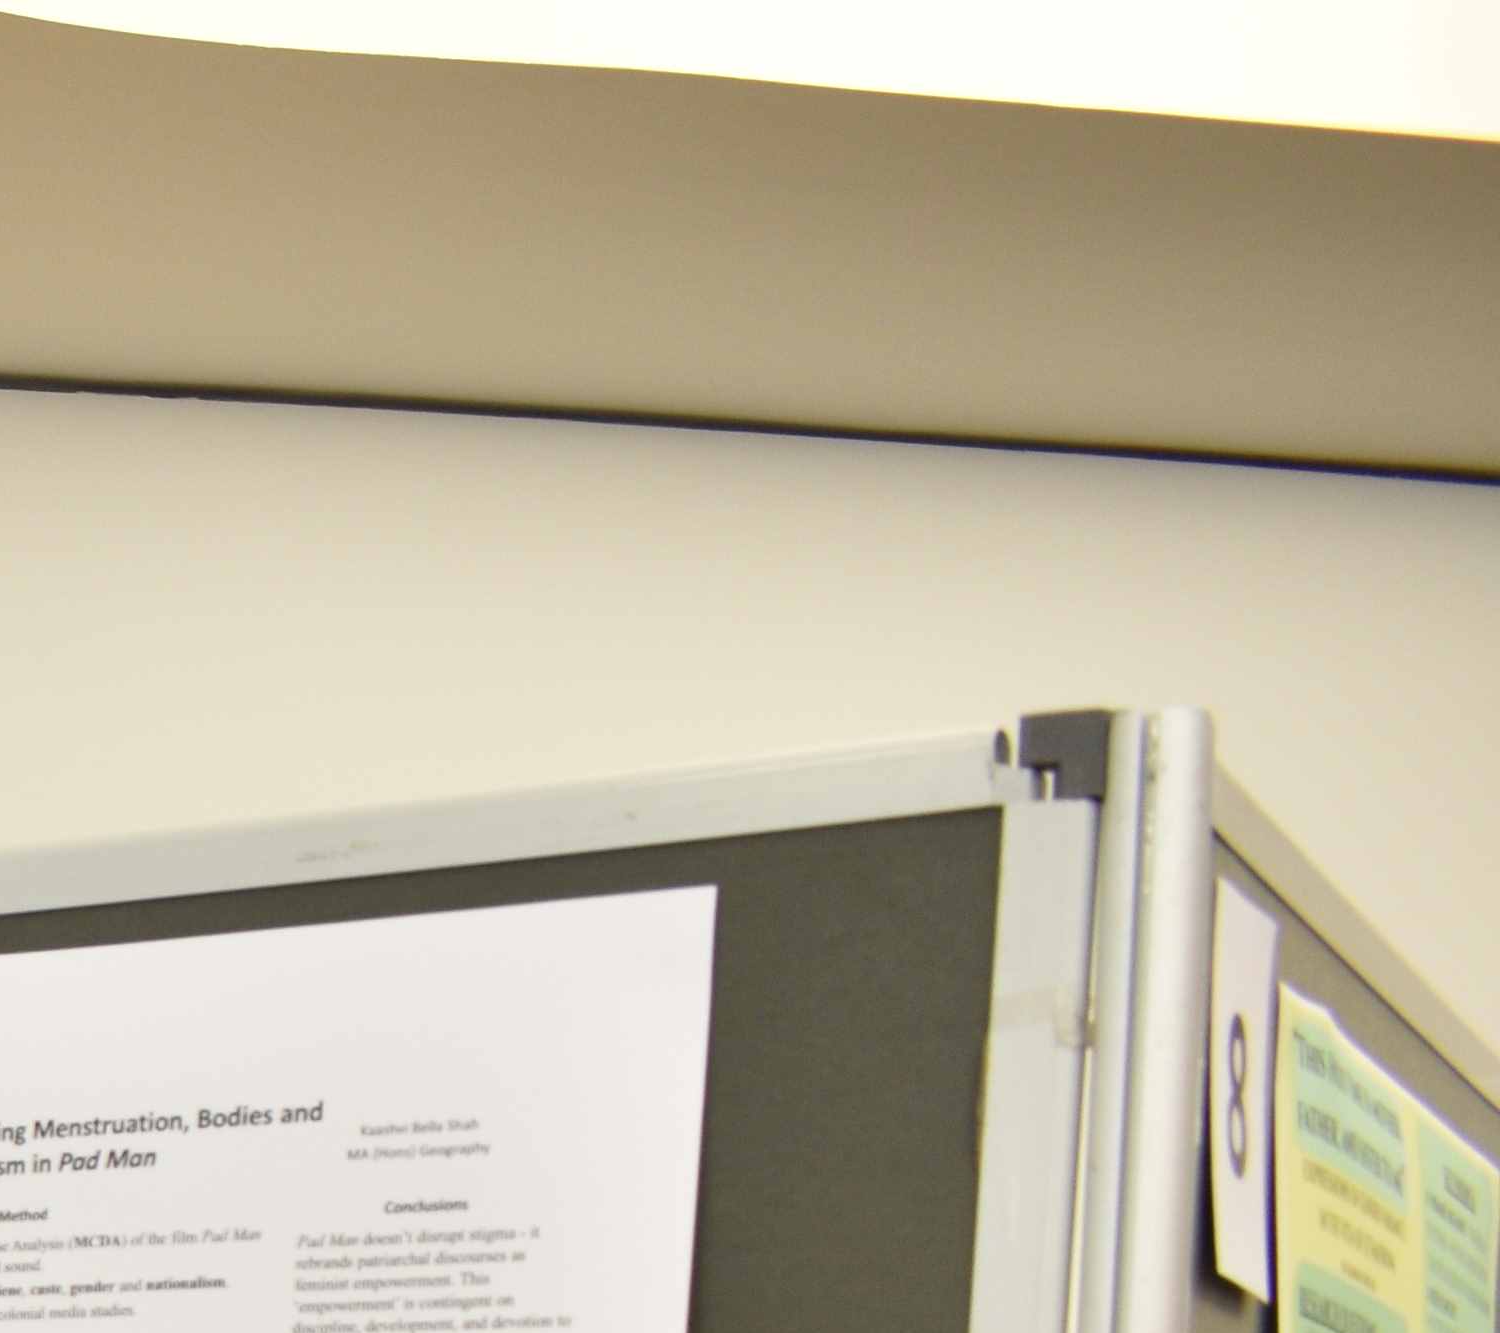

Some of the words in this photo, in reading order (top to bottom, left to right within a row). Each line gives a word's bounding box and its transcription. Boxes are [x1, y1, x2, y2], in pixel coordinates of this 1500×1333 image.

[1227, 1013, 1248, 1180] 8
[32, 1114, 189, 1137] Menstruation,
[197, 1106, 273, 1127] Bodies
[280, 1101, 323, 1123] and
[32, 1154, 51, 1172] in
[58, 1150, 100, 1171] Pad
[105, 1149, 156, 1167] Man
[420, 1143, 490, 1157] Geography
[384, 1201, 468, 1213] Conclusions
[12, 1239, 64, 1251] Analysis
[68, 1235, 127, 1248] (MCDA)
[130, 1233, 144, 1245] of
[146, 1233, 166, 1244] the
[171, 1231, 198, 1243] film
[202, 1229, 228, 1241] Pad
[233, 1229, 261, 1240] Man
[70, 1281, 115, 1296] gender
[120, 1280, 141, 1291] and
